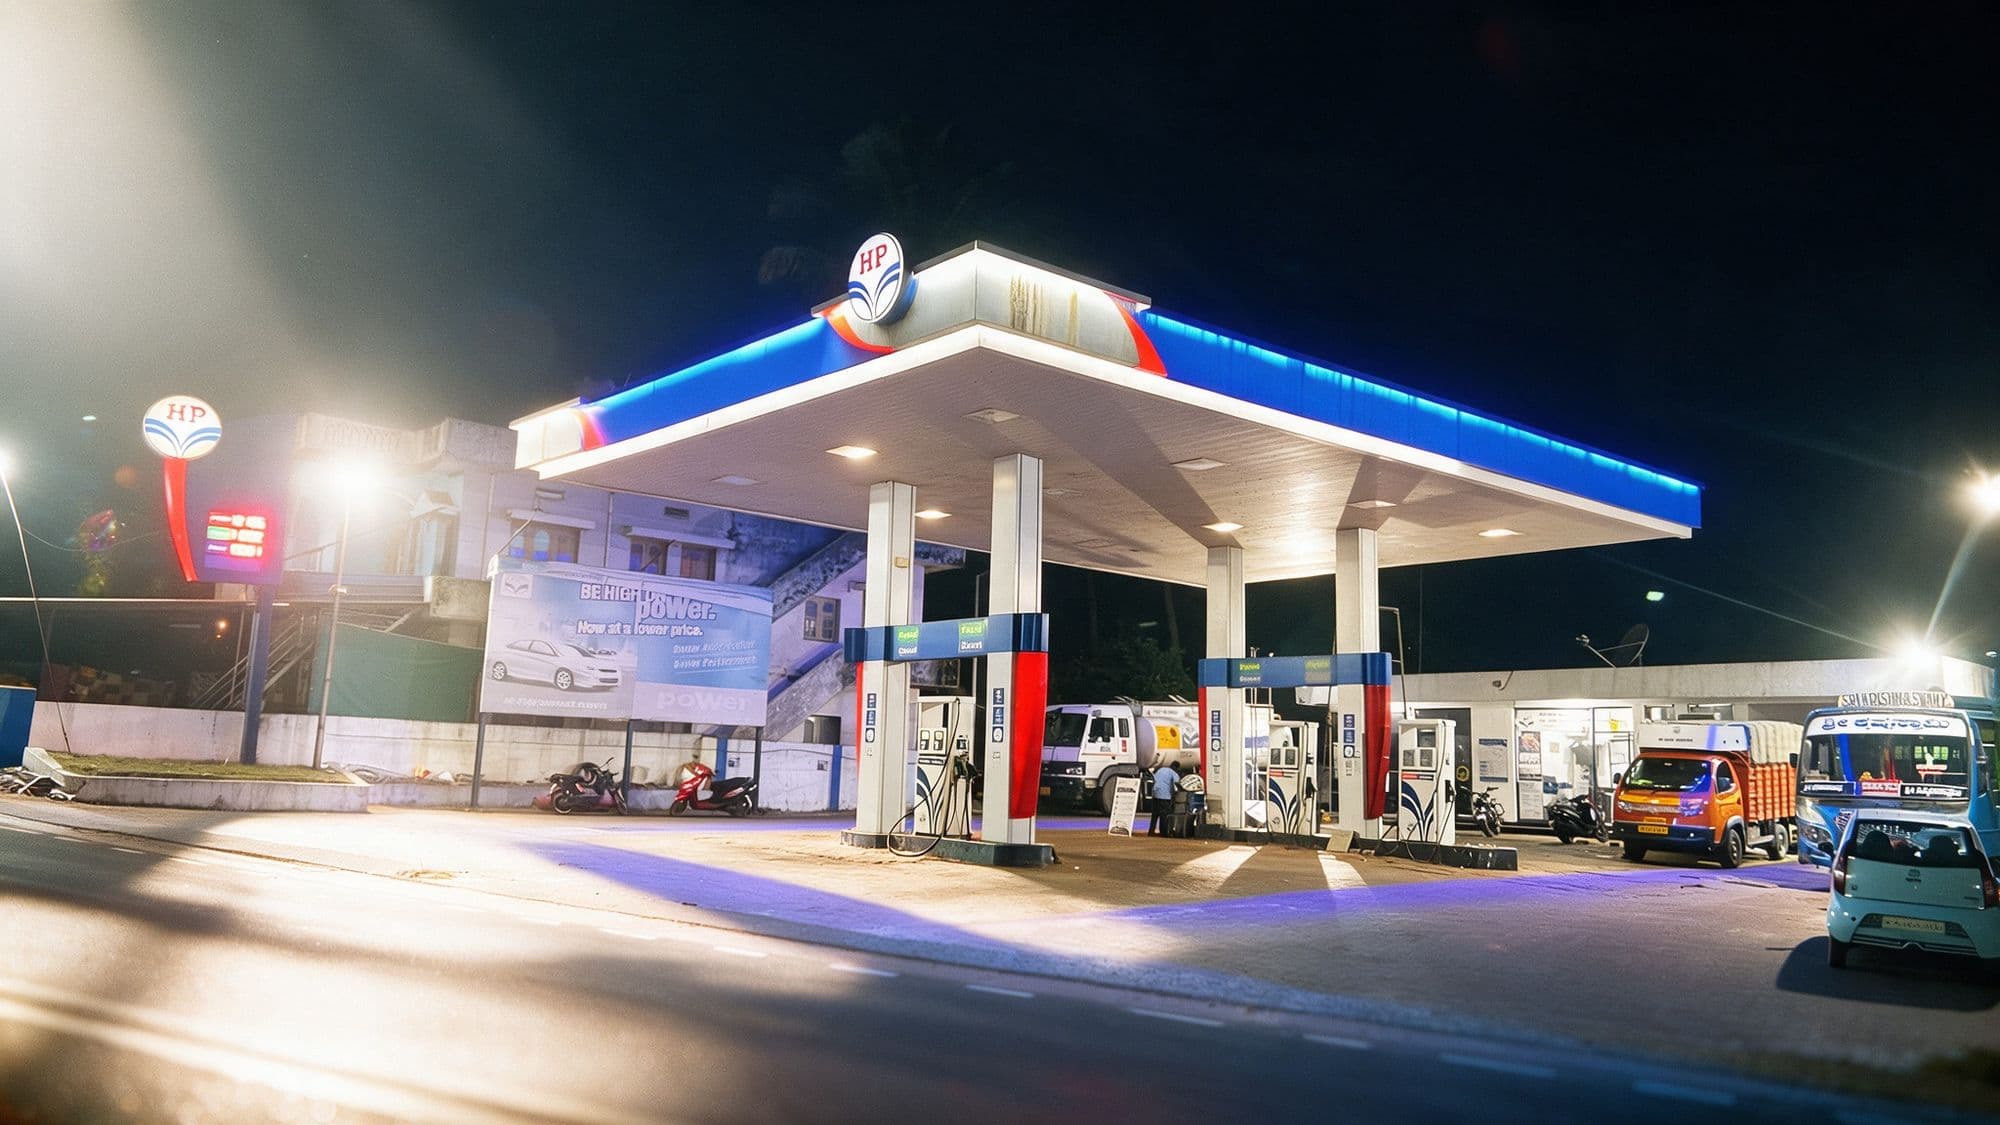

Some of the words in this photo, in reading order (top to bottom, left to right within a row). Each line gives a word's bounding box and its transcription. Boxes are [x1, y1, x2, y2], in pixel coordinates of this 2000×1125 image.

[859, 244, 888, 275] HP
[166, 403, 206, 423] HP
[580, 582, 602, 600] BE
[577, 619, 605, 635] Now
[607, 621, 622, 635] at
